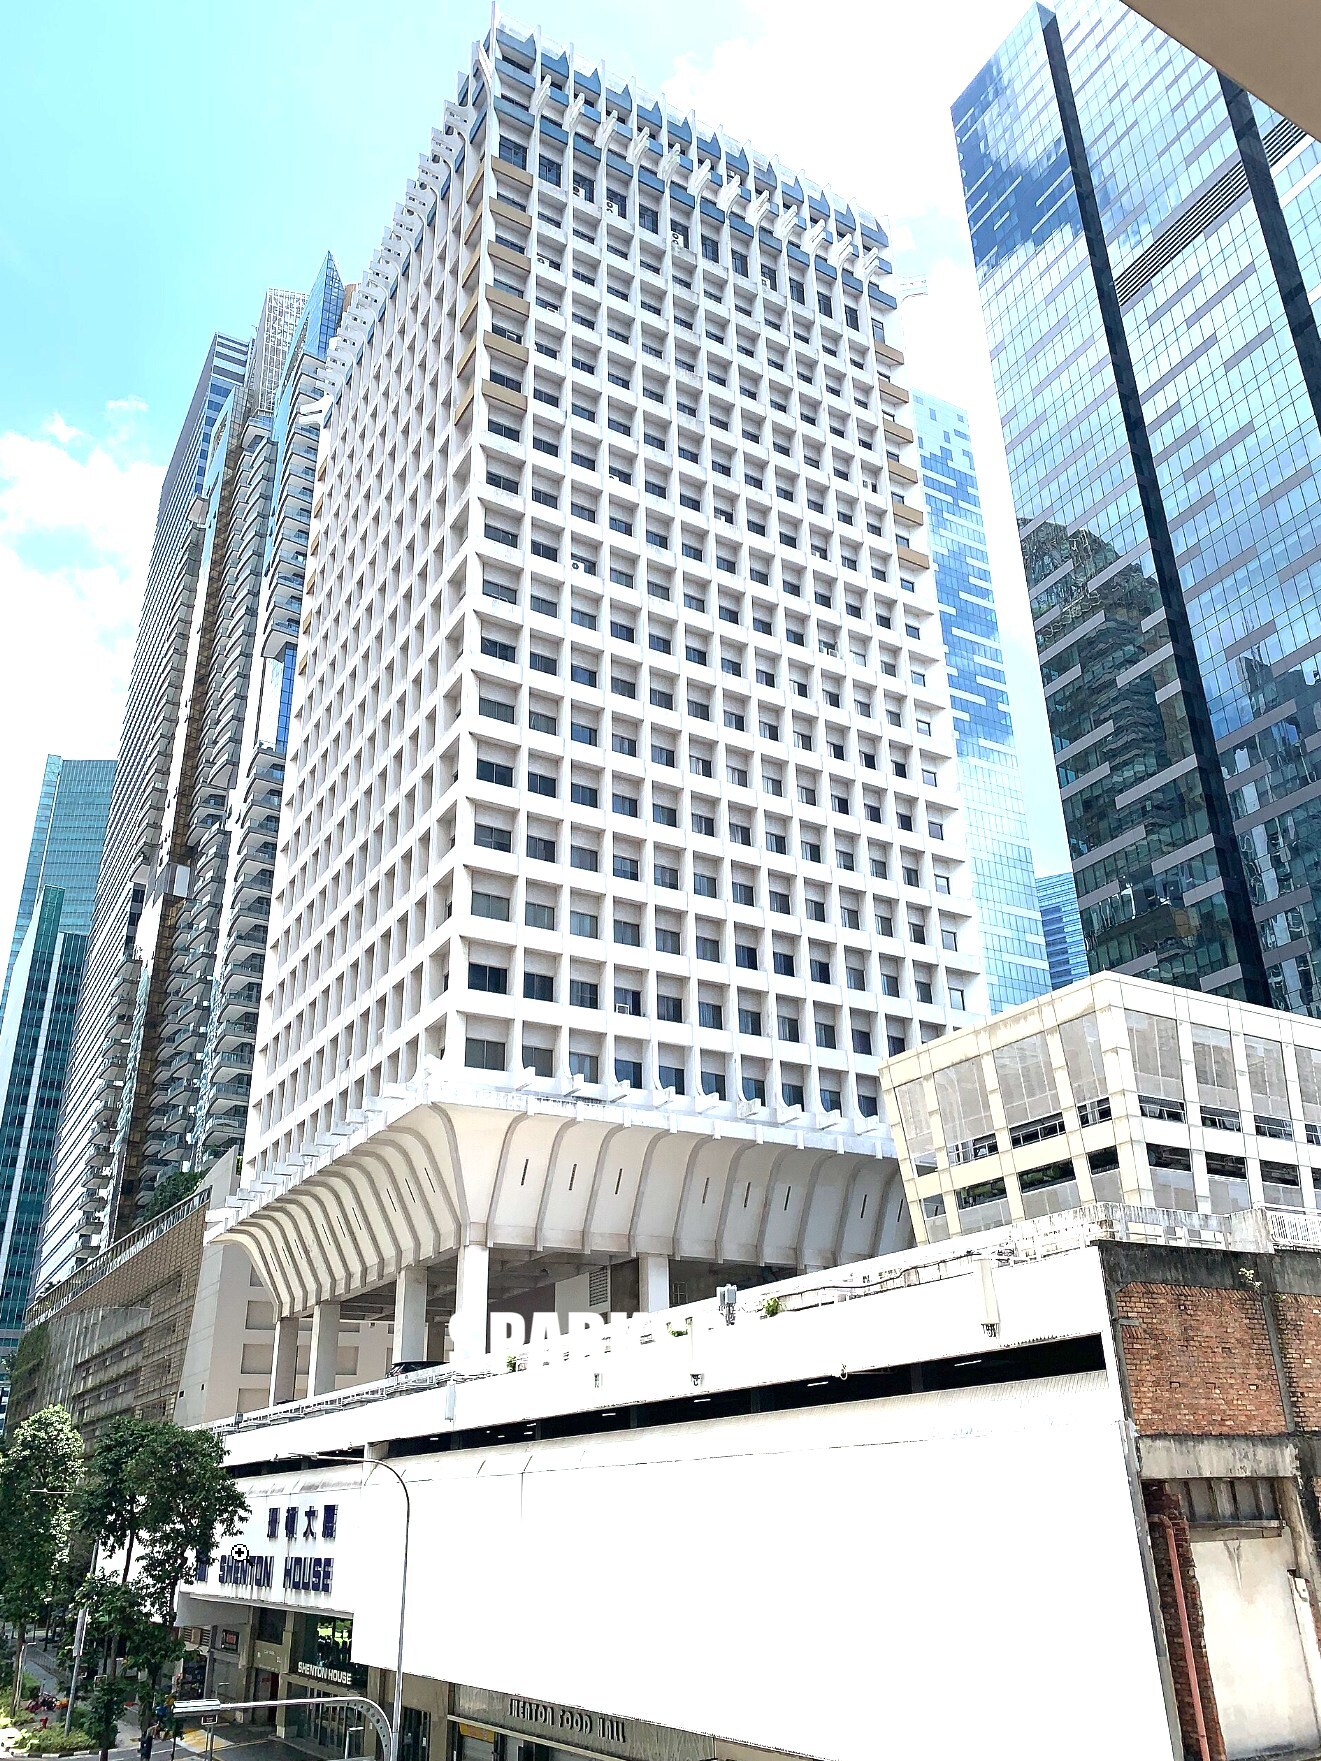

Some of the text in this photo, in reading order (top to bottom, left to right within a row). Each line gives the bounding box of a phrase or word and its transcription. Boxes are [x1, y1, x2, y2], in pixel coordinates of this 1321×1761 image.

[219, 1554, 334, 1593] SHENTON HOUSE
[298, 1661, 352, 1685] SHENTON HOUSE
[508, 1698, 626, 1744] SHENTON FOOD HALL
